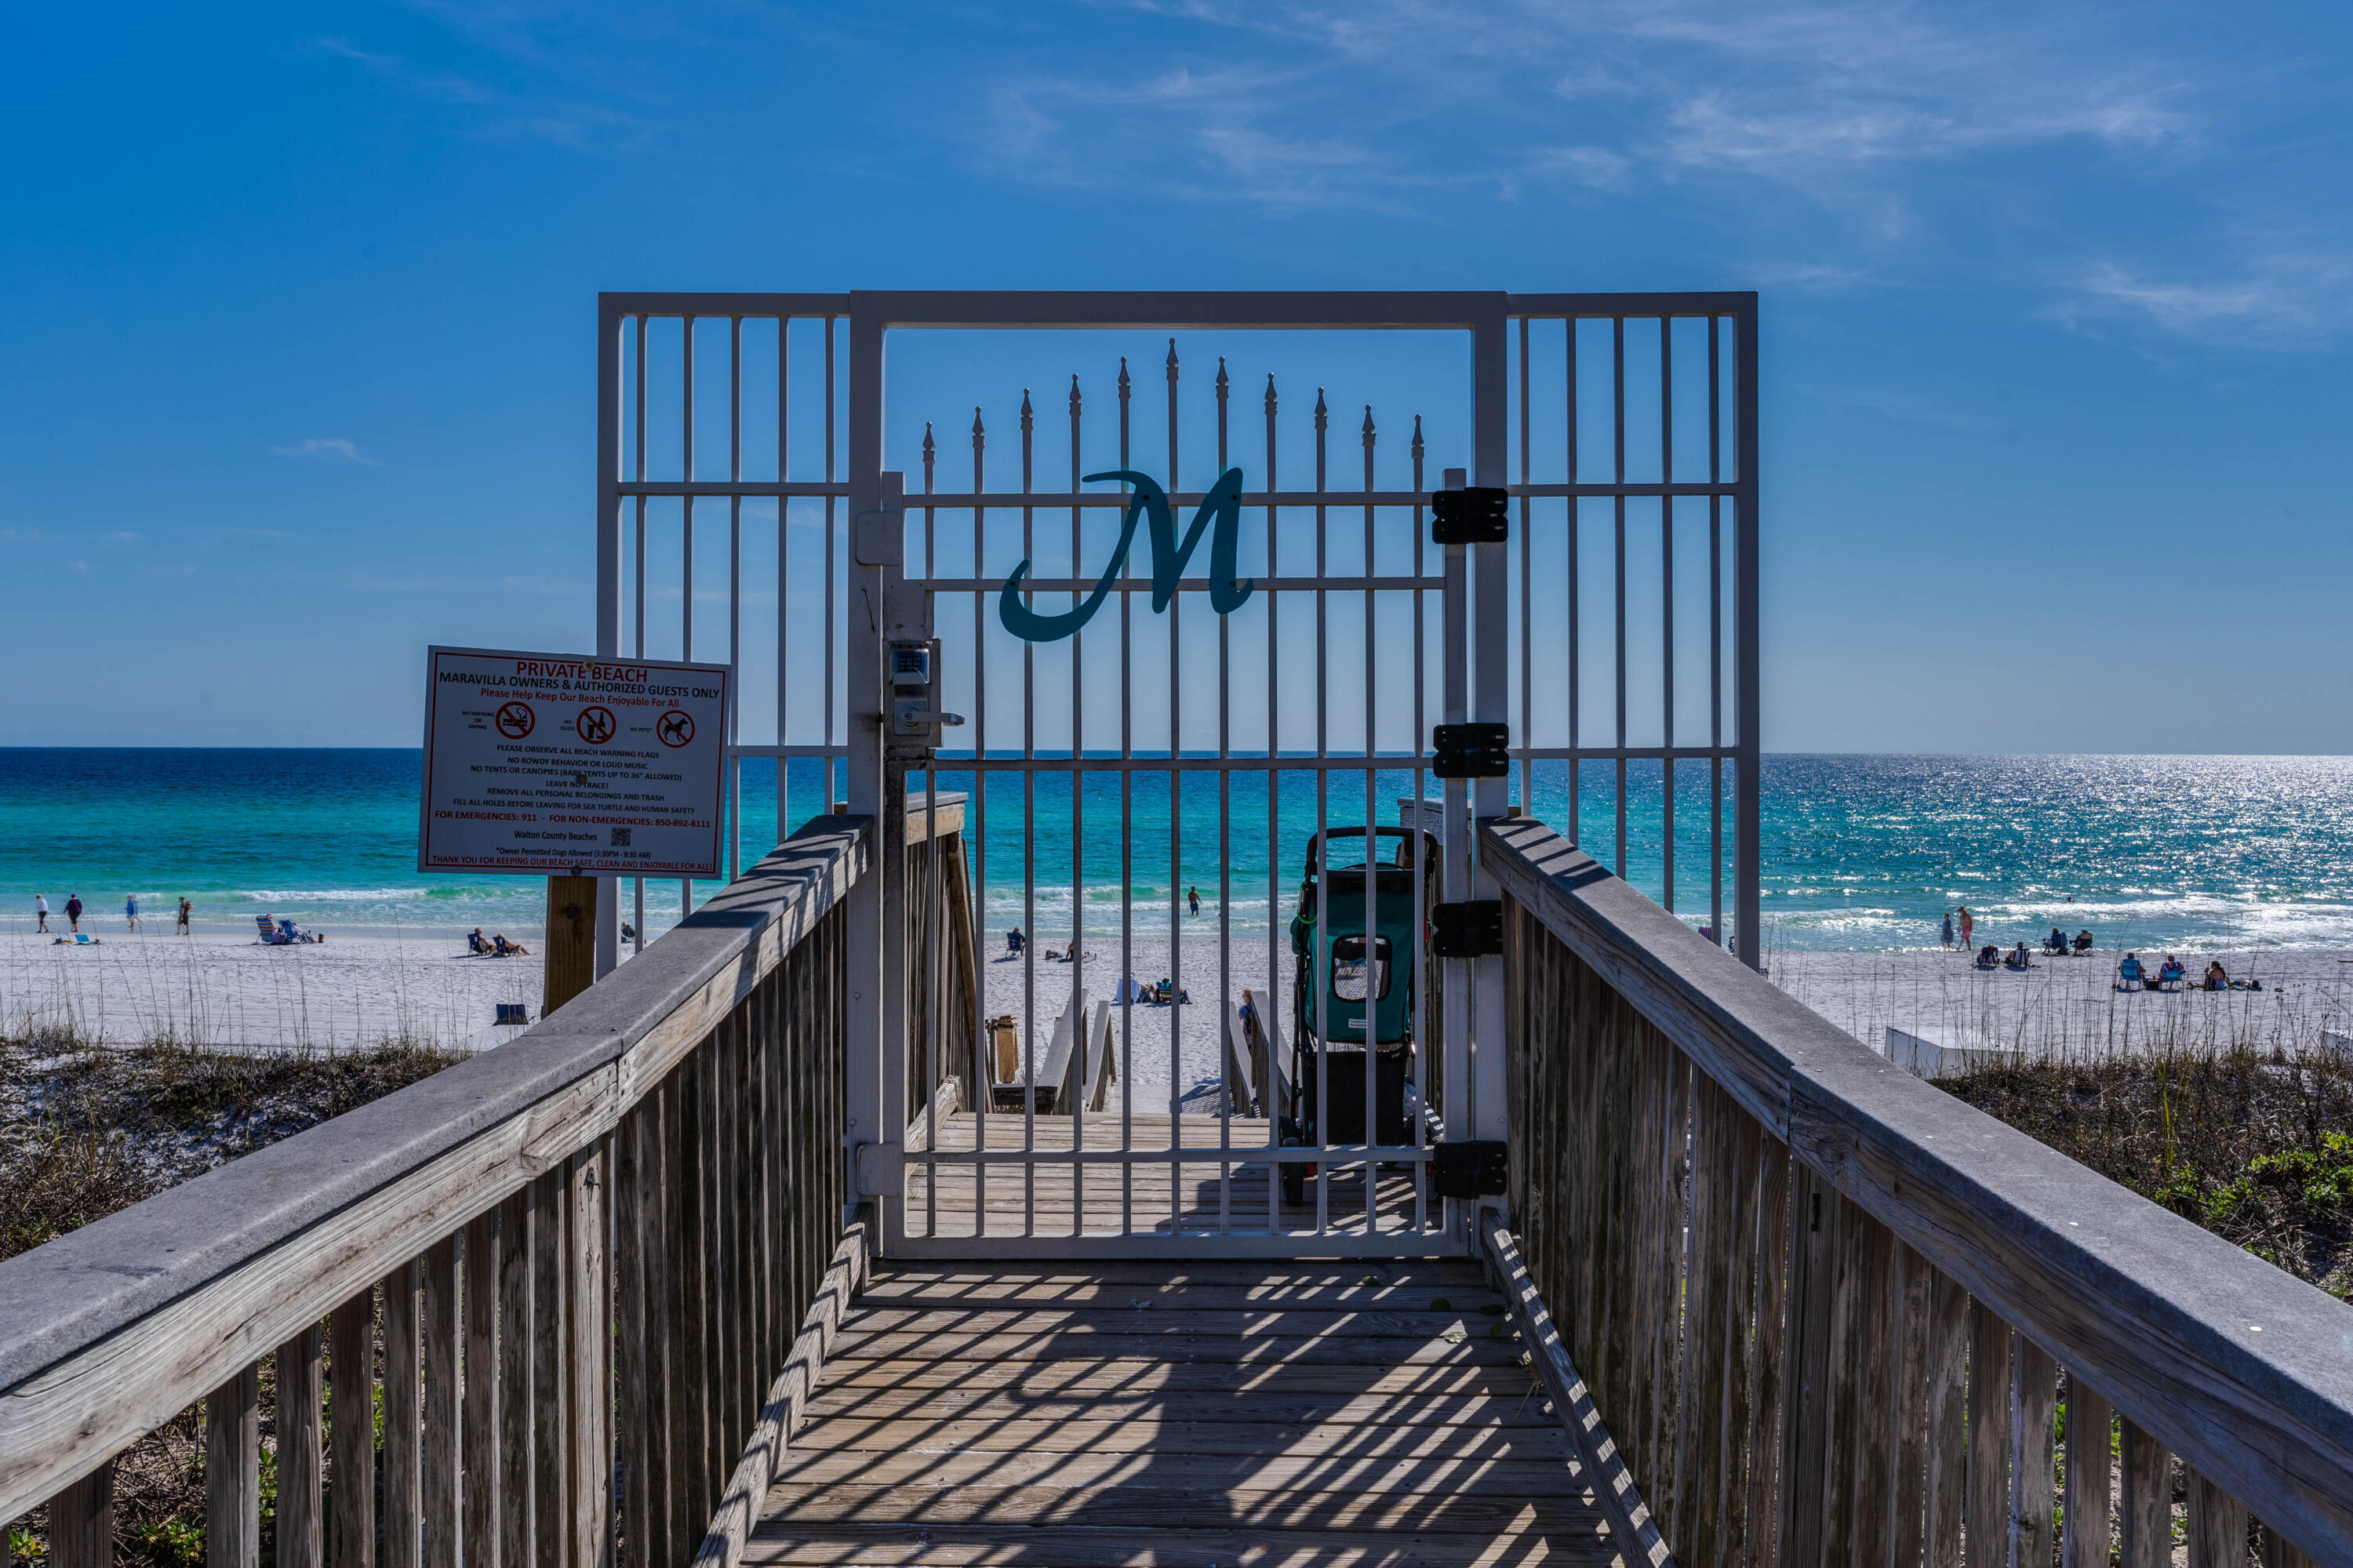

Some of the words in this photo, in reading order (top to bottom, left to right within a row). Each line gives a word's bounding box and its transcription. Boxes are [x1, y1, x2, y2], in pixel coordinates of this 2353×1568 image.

[999, 467, 1253, 642] M
[517, 661, 586, 678] PRIVATE
[592, 667, 647, 682] BEACH
[440, 672, 506, 685] MARAVILLA
[510, 676, 558, 689] OWNERS
[562, 681, 570, 689] &
[574, 681, 645, 693] AUTHORIZED
[648, 686, 689, 697] GUESTS
[692, 688, 720, 698] ONLY
[481, 688, 509, 697] Please
[512, 690, 532, 700] Help
[536, 692, 557, 702] Keep
[560, 693, 575, 701] Our
[579, 694, 605, 703] Beach
[608, 696, 649, 706] Enjoyable
[456, 811, 519, 820] EMERGENCIES:
[569, 816, 653, 825] NON-EMERGENCIES:
[542, 831, 566, 841] County
